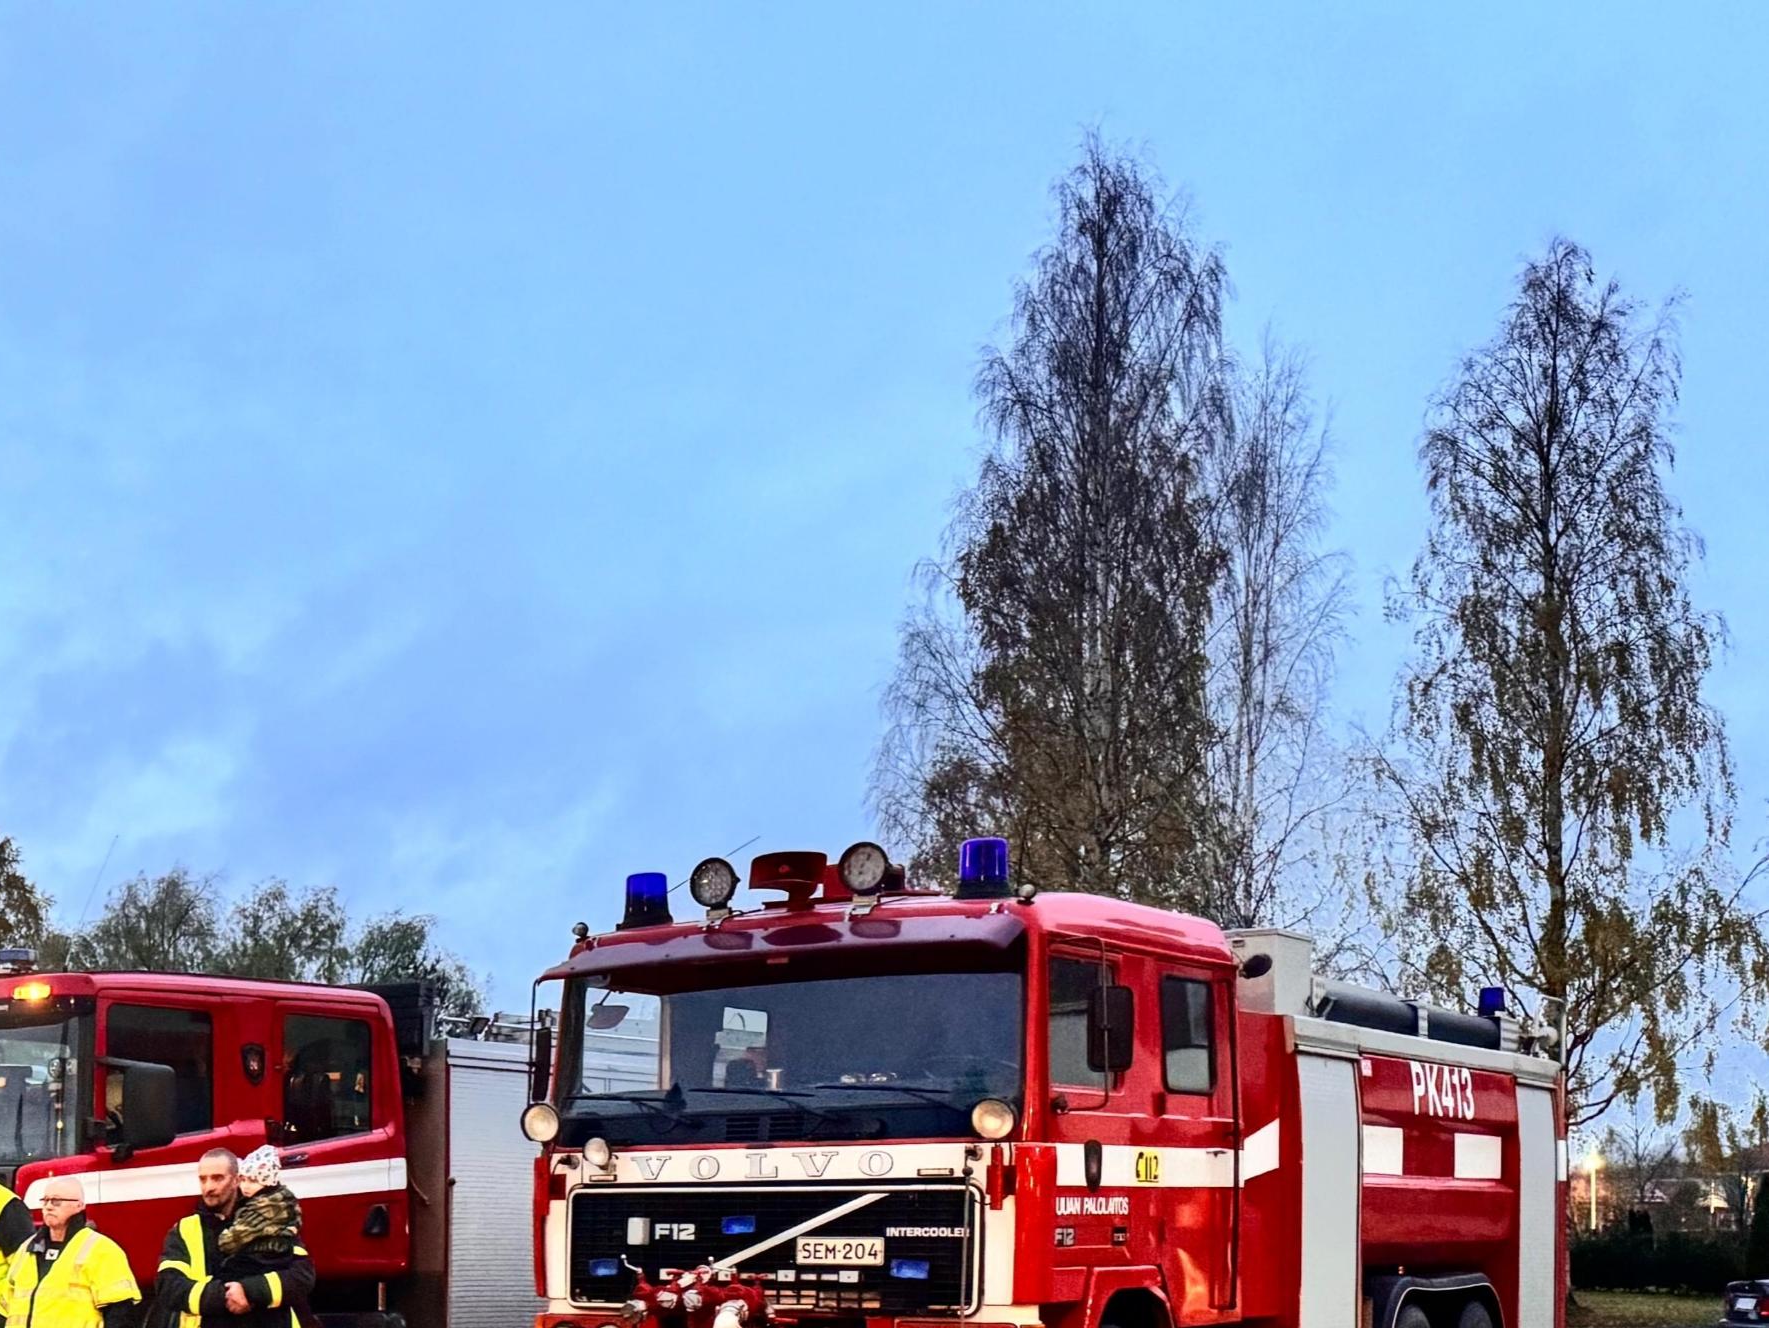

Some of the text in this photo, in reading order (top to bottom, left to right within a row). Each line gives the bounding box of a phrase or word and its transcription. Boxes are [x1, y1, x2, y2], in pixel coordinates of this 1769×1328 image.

[1410, 1061, 1475, 1120] PK413
[630, 1151, 895, 1181] VOLVO
[655, 1224, 695, 1240] F12
[1054, 1228, 1075, 1246] F12
[801, 1242, 879, 1260] SEM-204
